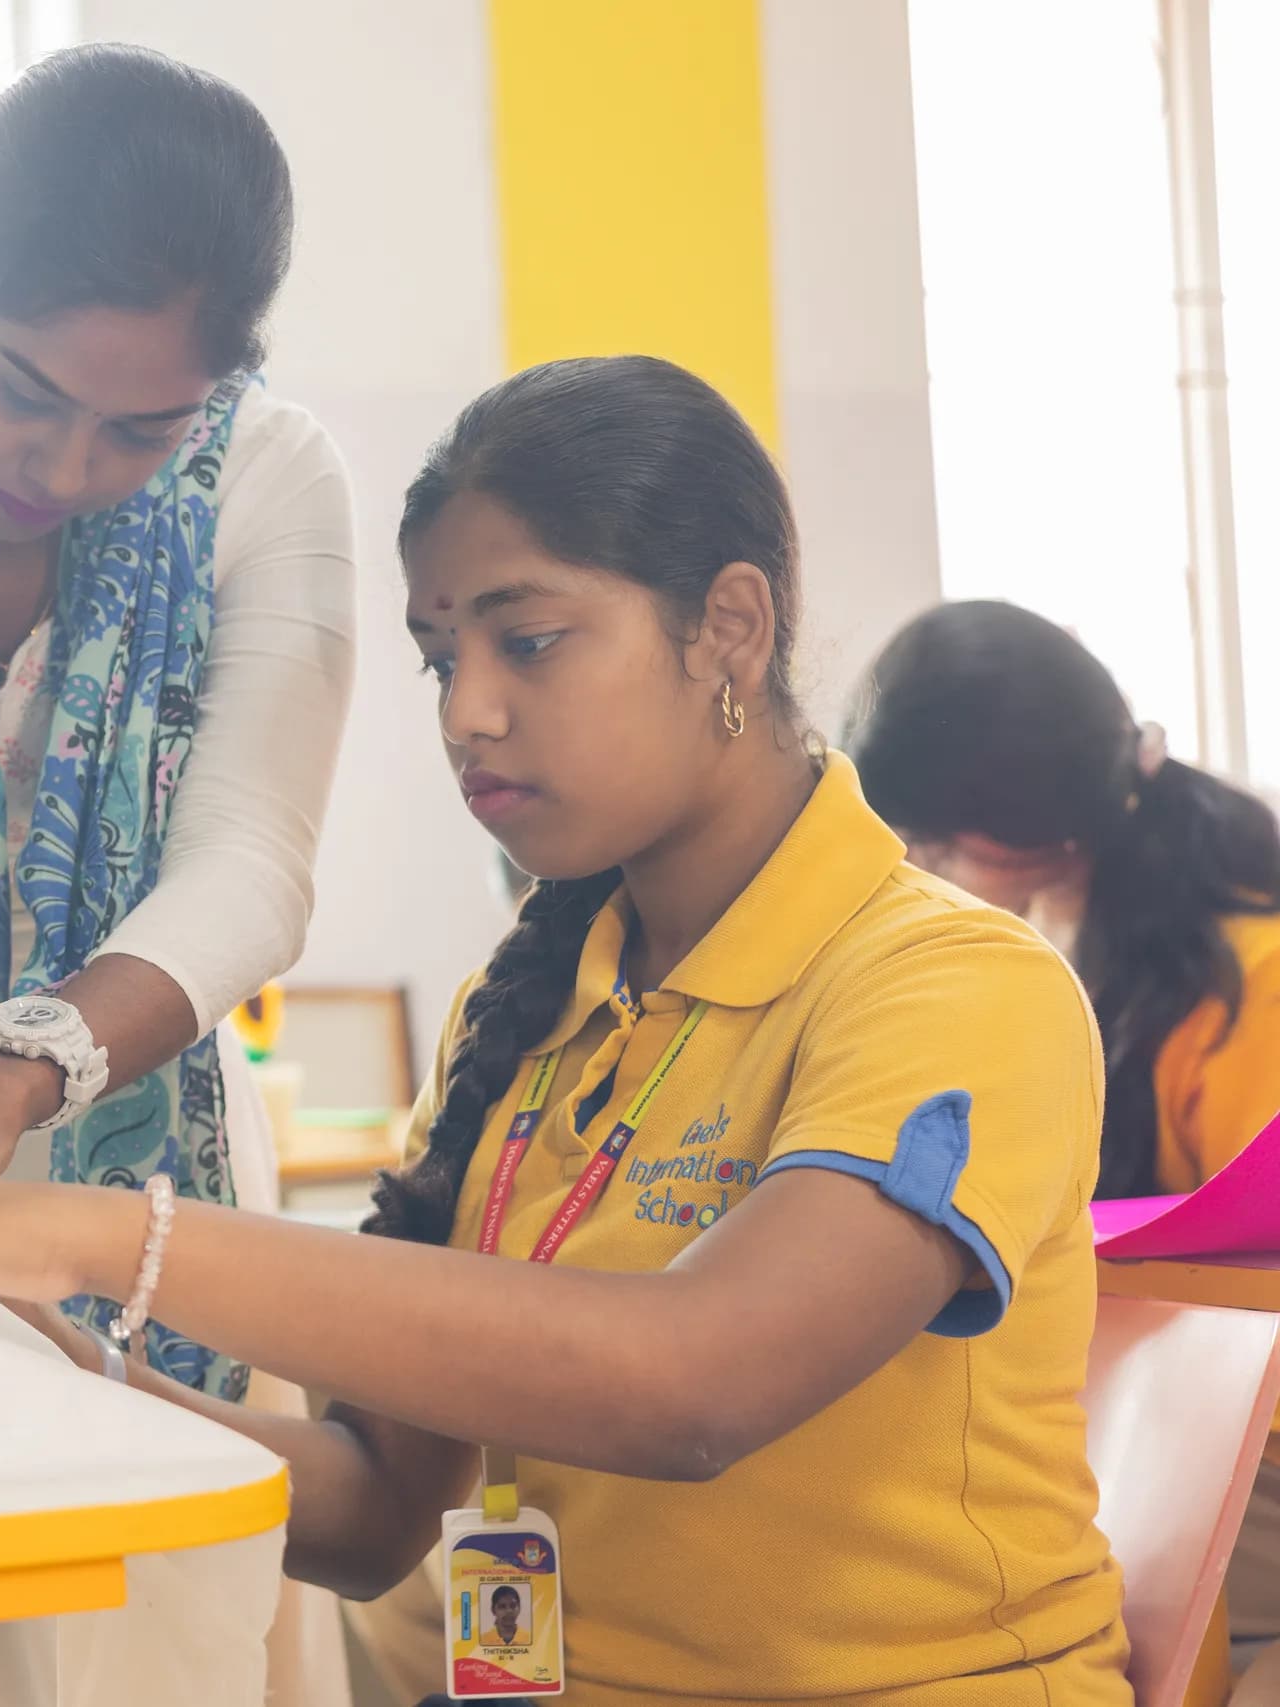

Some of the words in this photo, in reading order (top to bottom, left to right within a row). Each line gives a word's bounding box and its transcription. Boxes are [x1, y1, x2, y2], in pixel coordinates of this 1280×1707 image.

[495, 1141, 519, 1199] SCHOOL
[577, 1159, 609, 1199] VAELS
[635, 1187, 728, 1229] School
